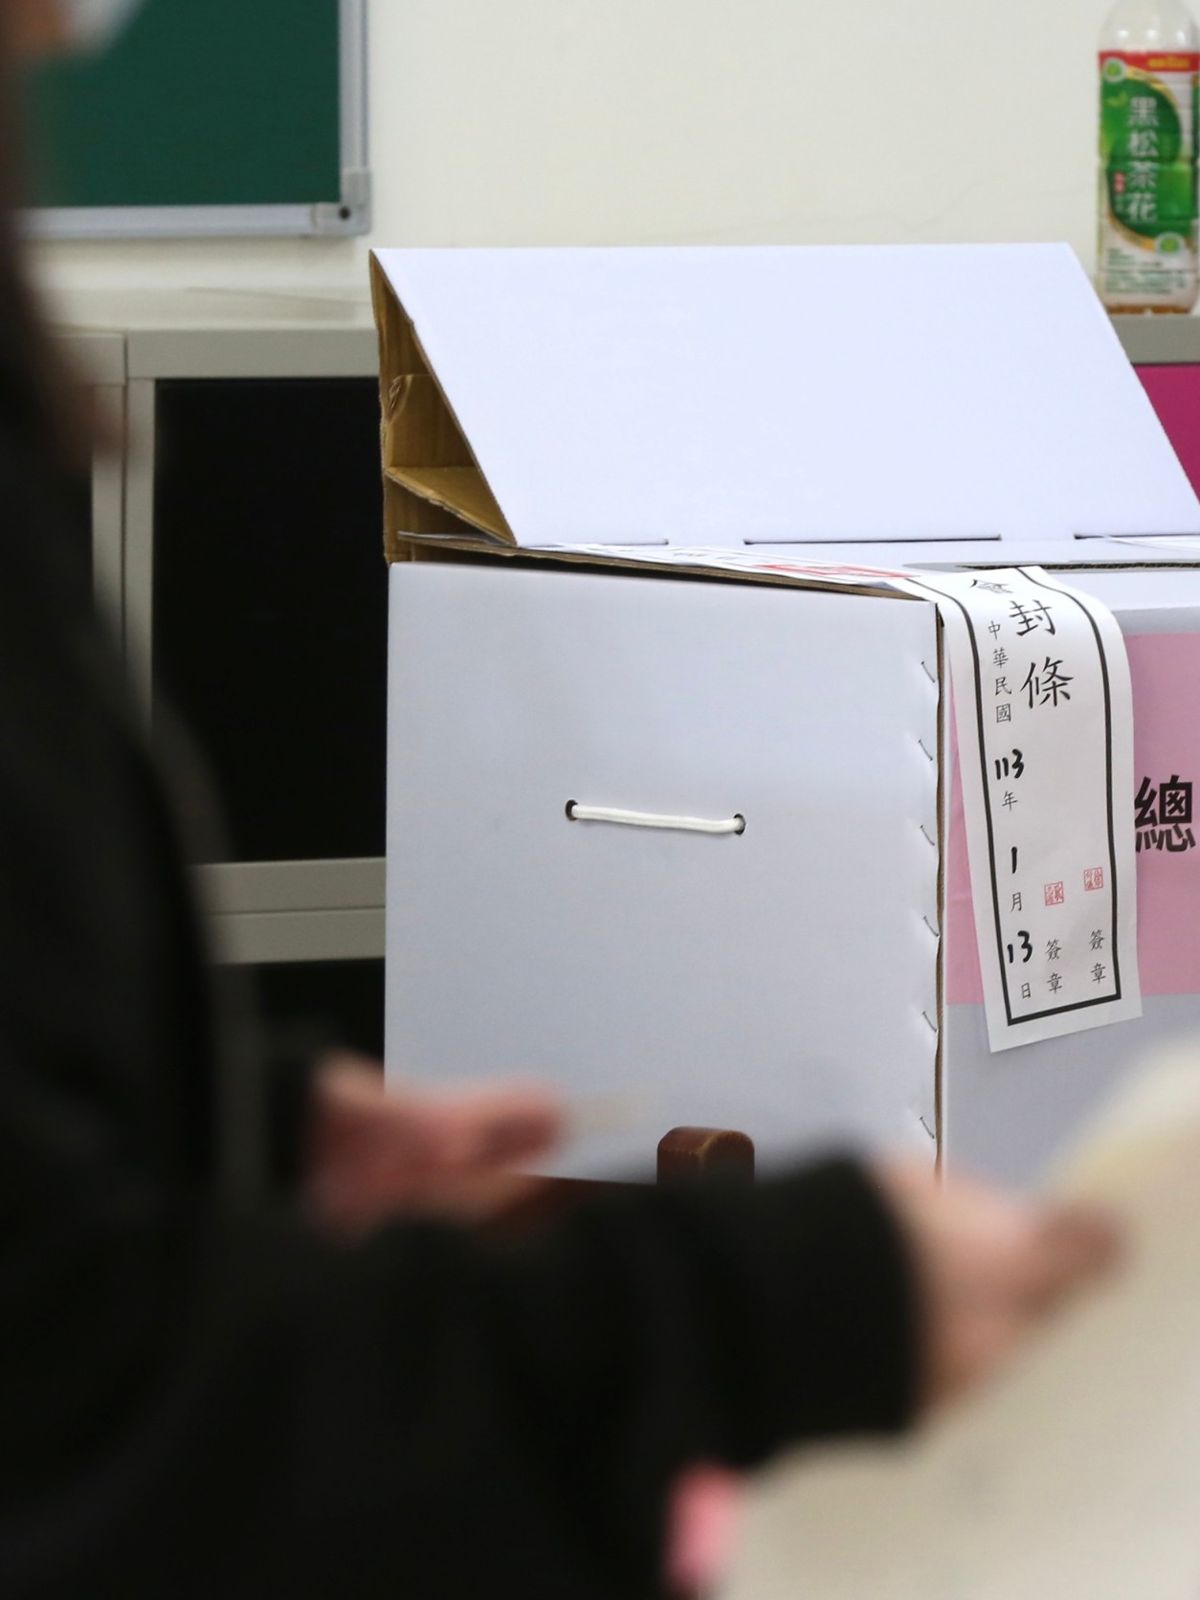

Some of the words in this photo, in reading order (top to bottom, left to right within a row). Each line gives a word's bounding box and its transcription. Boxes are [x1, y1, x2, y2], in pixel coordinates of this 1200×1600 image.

[1126, 96, 1159, 223] 黑松茶花
[1009, 599, 1074, 709] 封條
